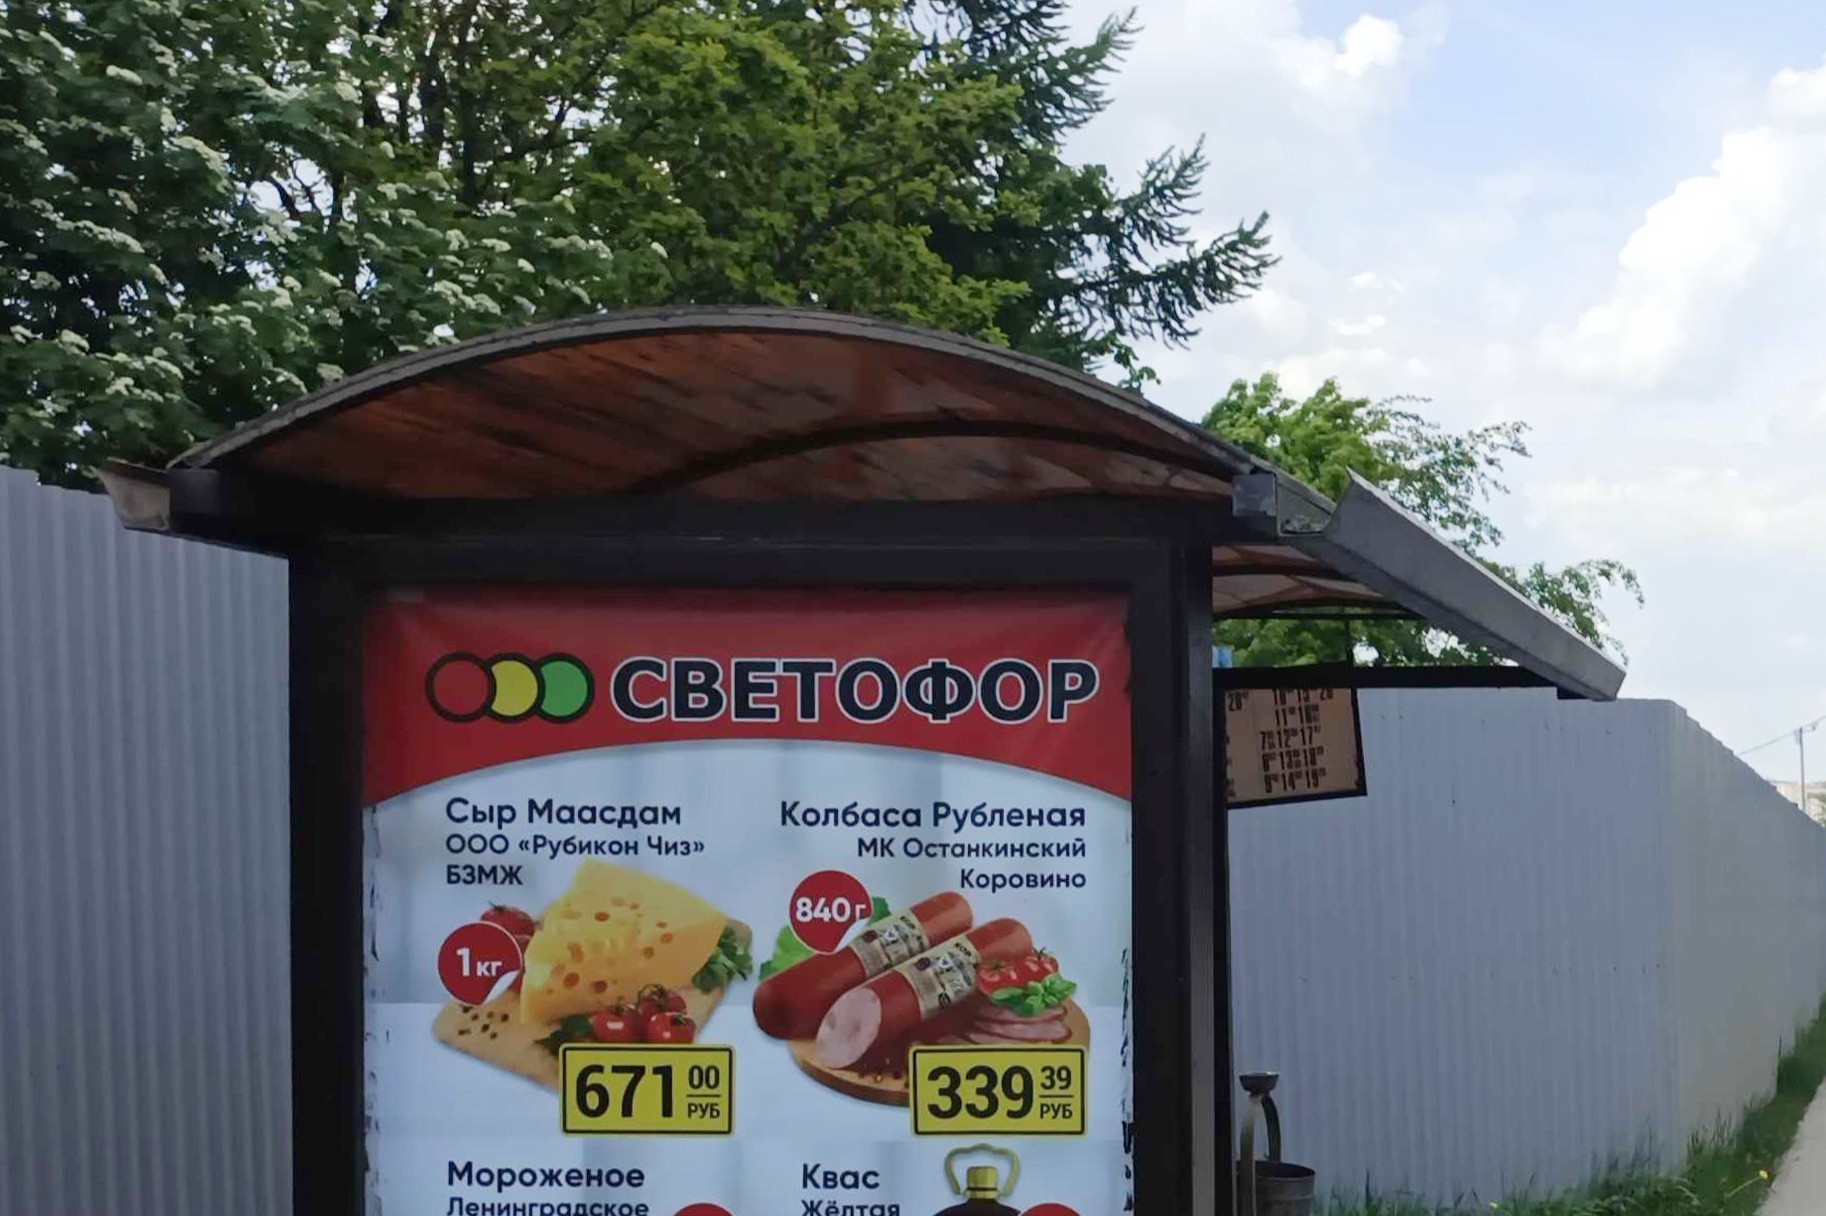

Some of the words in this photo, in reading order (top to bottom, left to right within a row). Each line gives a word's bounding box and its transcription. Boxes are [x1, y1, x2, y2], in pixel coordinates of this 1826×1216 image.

[610, 656, 1099, 724] СВЕТОФОР
[446, 797, 516, 830] Сыр
[528, 798, 681, 828] Маасдам
[781, 801, 921, 828] Колбаса
[932, 801, 1086, 834] Рубленая
[446, 834, 509, 854] ООО
[519, 834, 638, 859] «Рубикон
[647, 836, 705, 856] Чиз»
[858, 838, 895, 857] МК
[903, 837, 1086, 858] Останкинский
[447, 865, 523, 885] БЗМЖ
[961, 868, 1087, 894] Коровино
[796, 897, 851, 922] 840
[456, 947, 470, 976] 1
[476, 961, 502, 976] кг
[688, 1065, 720, 1090] 00
[1040, 1066, 1072, 1090] 39
[576, 1064, 673, 1118] 671
[928, 1065, 1034, 1119] 339
[687, 1102, 721, 1119] РУБ
[1039, 1103, 1073, 1119] РУБ
[447, 1161, 645, 1193] Мороженое
[802, 1163, 880, 1189] Квас
